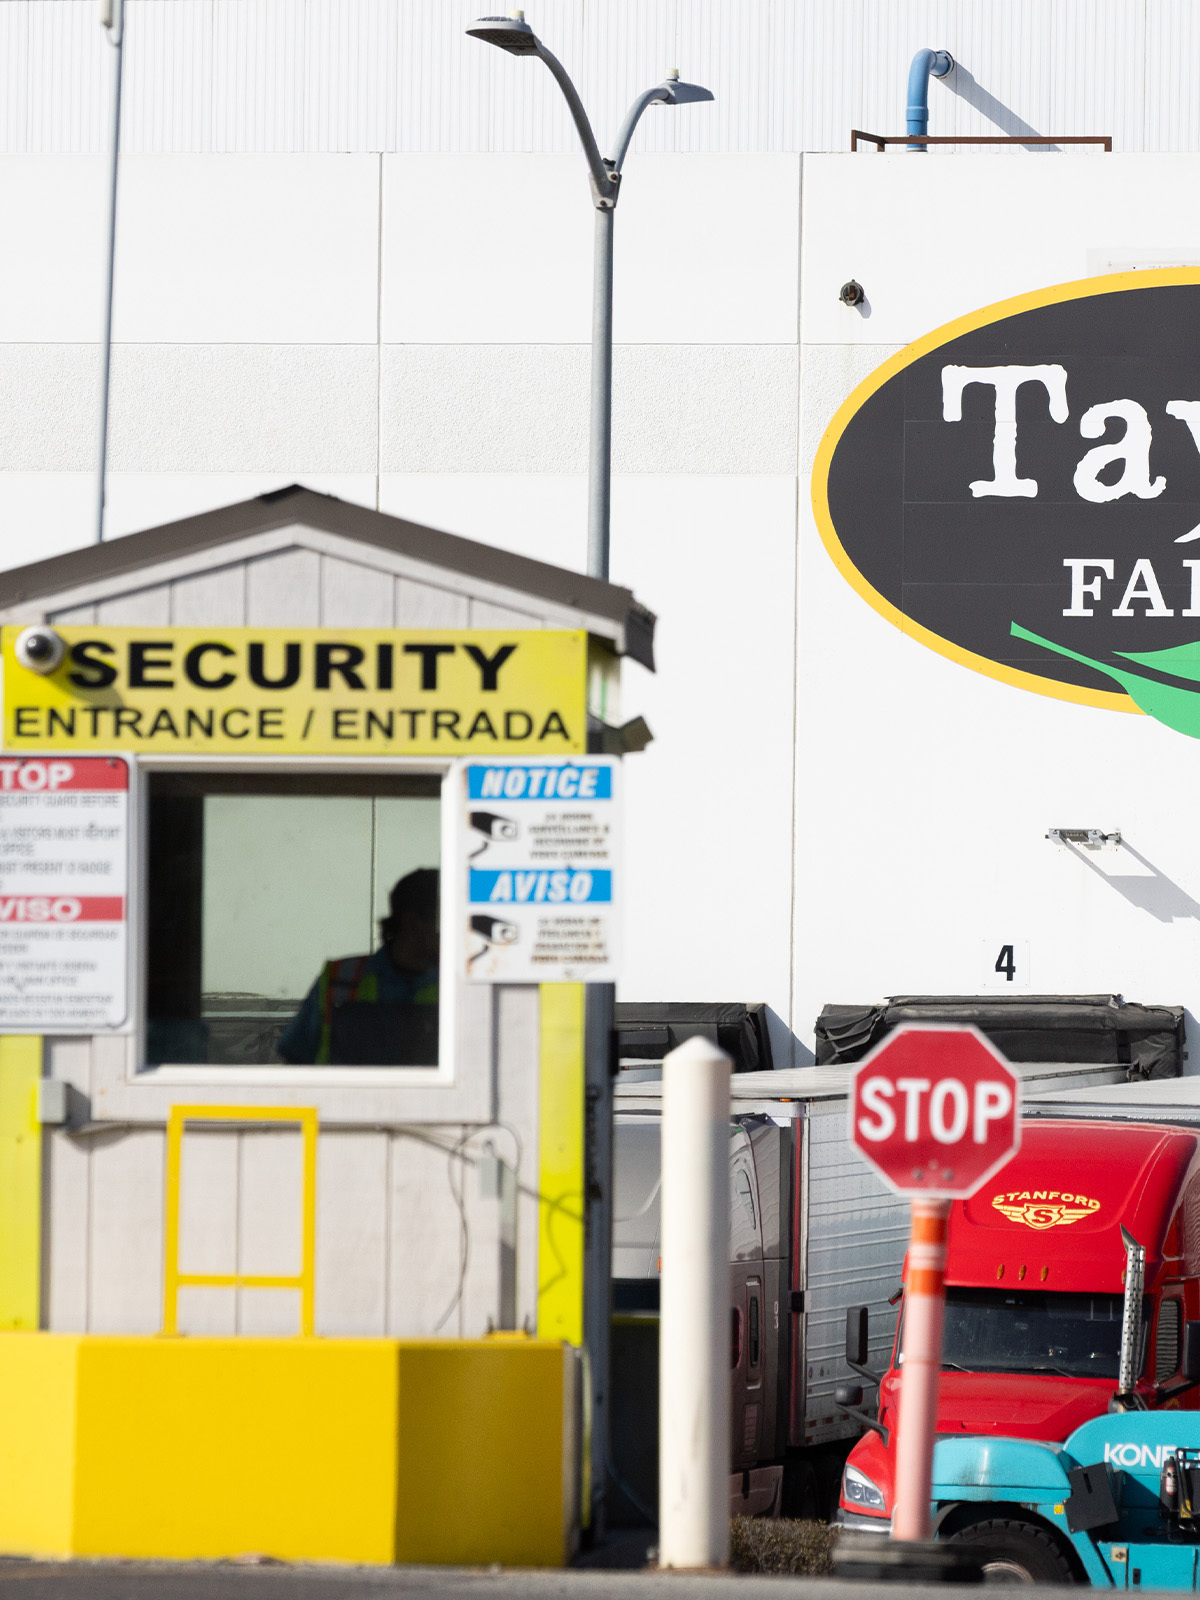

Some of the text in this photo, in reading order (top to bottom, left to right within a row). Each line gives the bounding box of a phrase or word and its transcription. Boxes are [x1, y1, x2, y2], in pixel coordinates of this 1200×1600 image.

[68, 641, 518, 692] SECURITY
[14, 707, 571, 742] ENTRANCE / ENTRADA
[0, 761, 75, 792] TOP
[480, 768, 600, 799] NOTICE
[489, 871, 594, 903] AVISO
[0, 896, 82, 922] VISO
[995, 945, 1016, 981] 4
[858, 1075, 1012, 1145] STOP
[992, 1190, 1101, 1211] STANFORD
